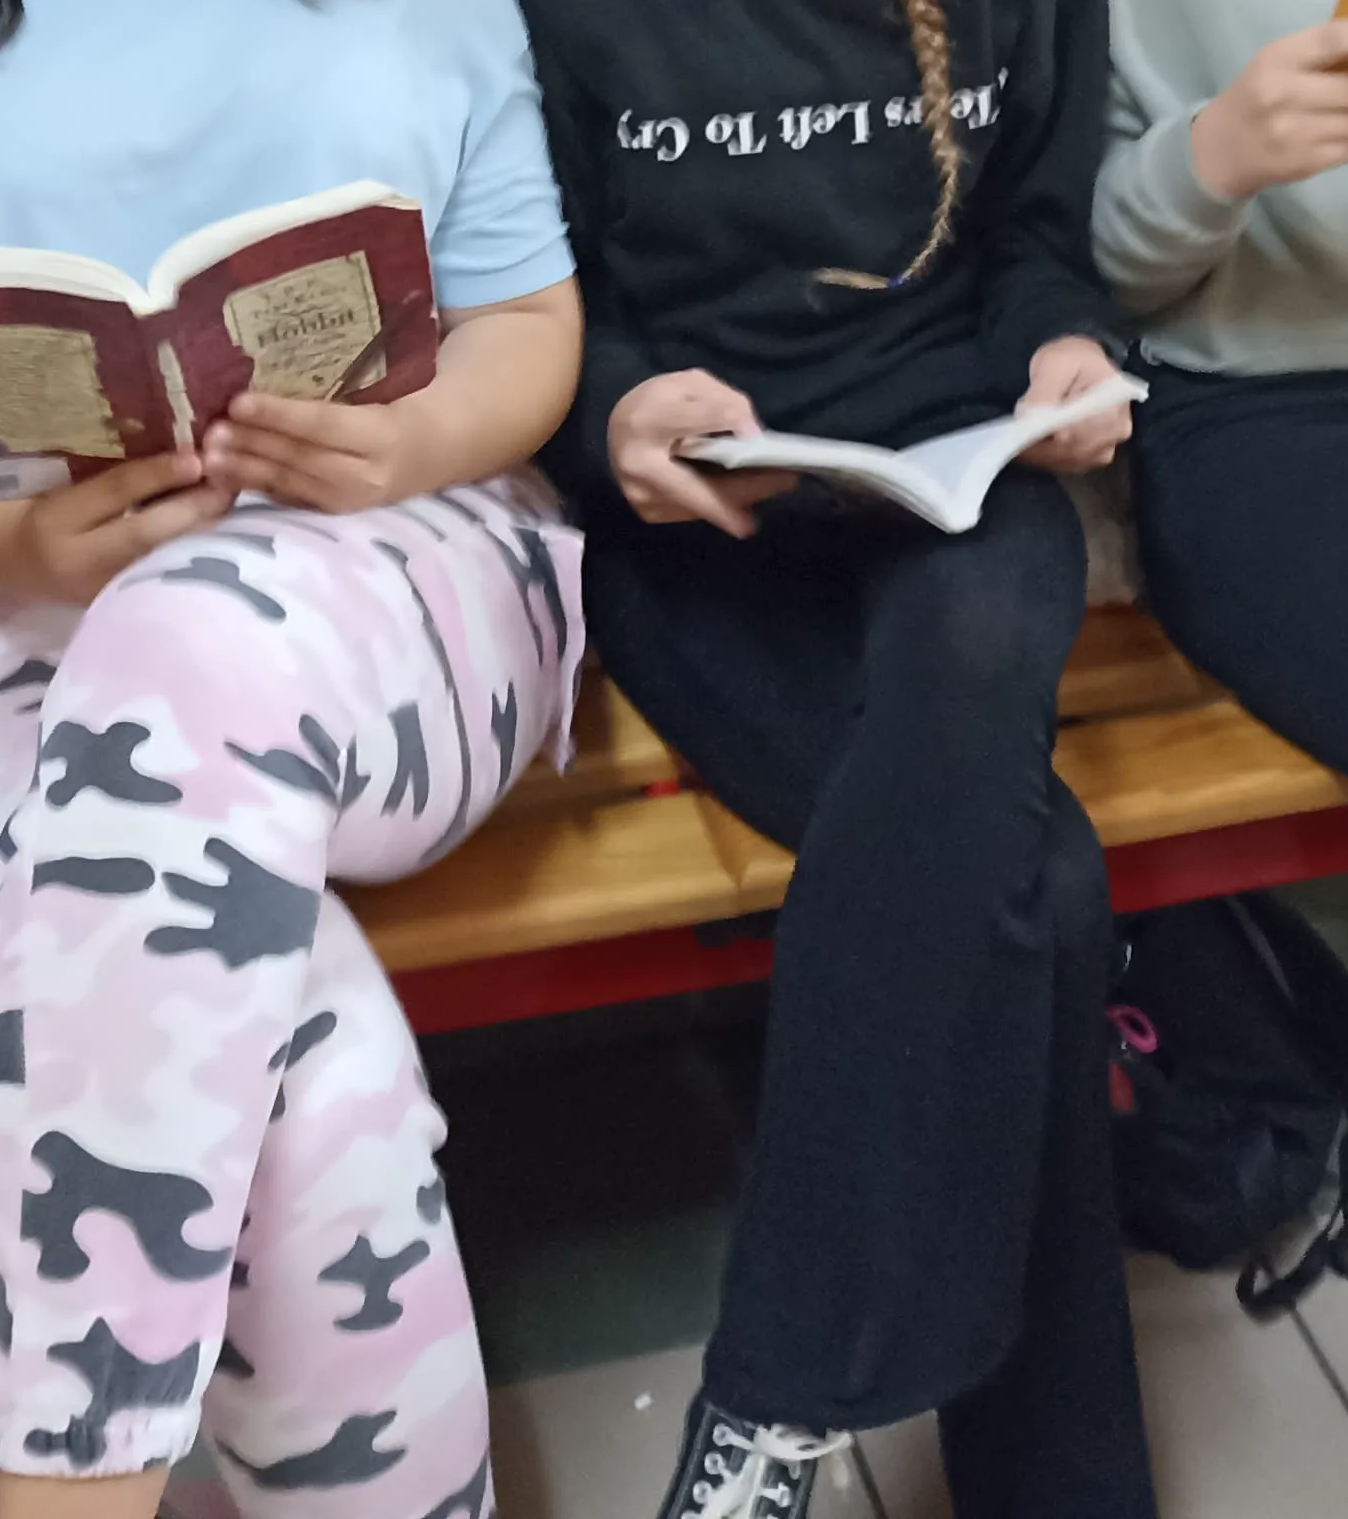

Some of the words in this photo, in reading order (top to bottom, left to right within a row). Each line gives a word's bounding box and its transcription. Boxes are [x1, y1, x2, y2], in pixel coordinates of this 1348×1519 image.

[777, 100, 871, 151] Left
[884, 85, 1001, 130] Ters
[616, 109, 690, 162] Cry
[704, 111, 767, 156] To
